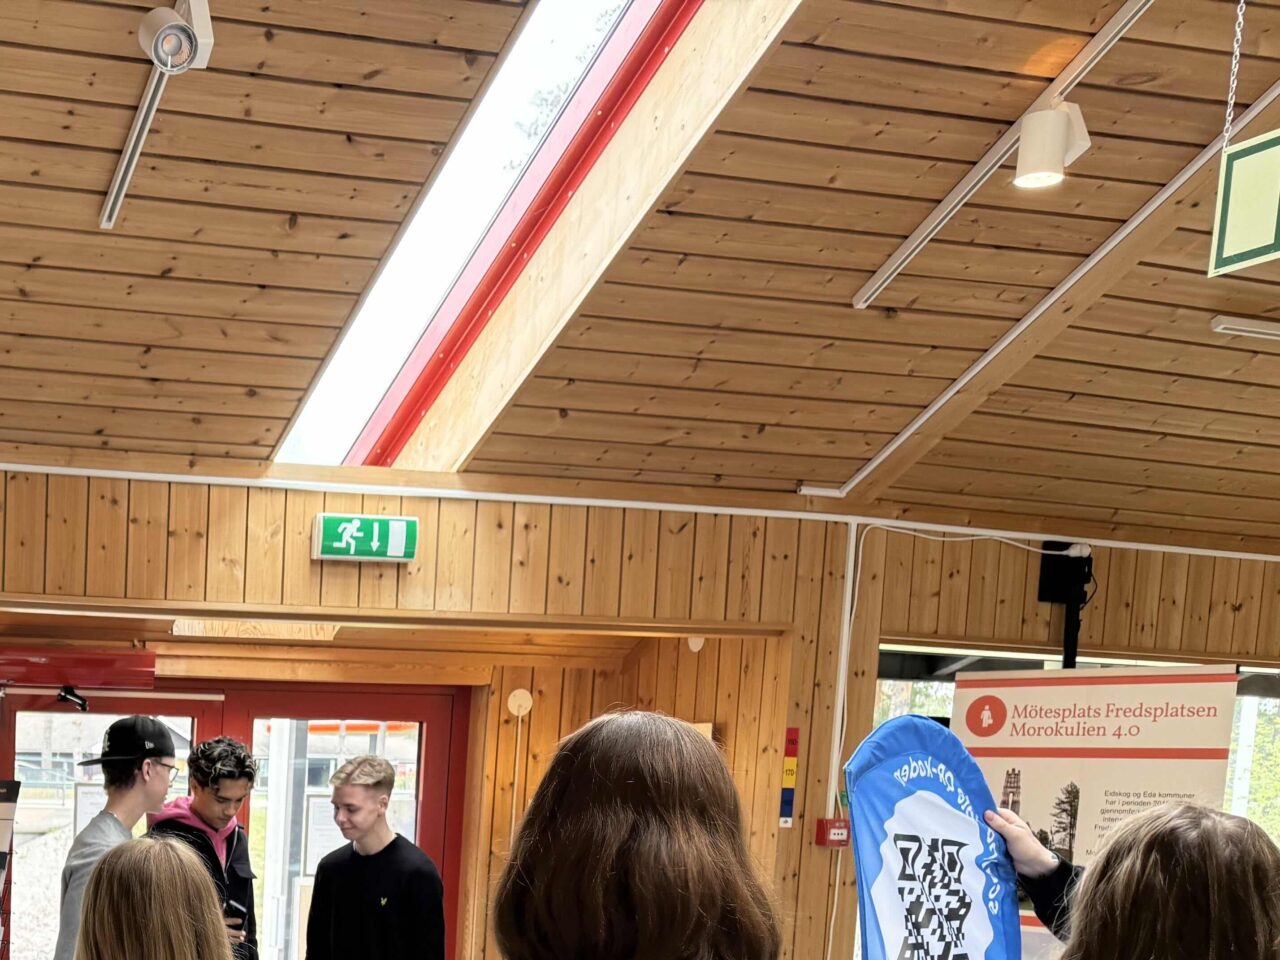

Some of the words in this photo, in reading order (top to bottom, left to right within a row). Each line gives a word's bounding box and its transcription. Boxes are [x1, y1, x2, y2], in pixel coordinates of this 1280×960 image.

[1012, 703, 1101, 723] Mötesplats
[1105, 702, 1218, 723] Fredsplatsen
[1010, 721, 1107, 737] Morokulien
[1112, 724, 1141, 740] 4.0
[784, 768, 795, 777] 170
[1104, 790, 1131, 799] Eidskog
